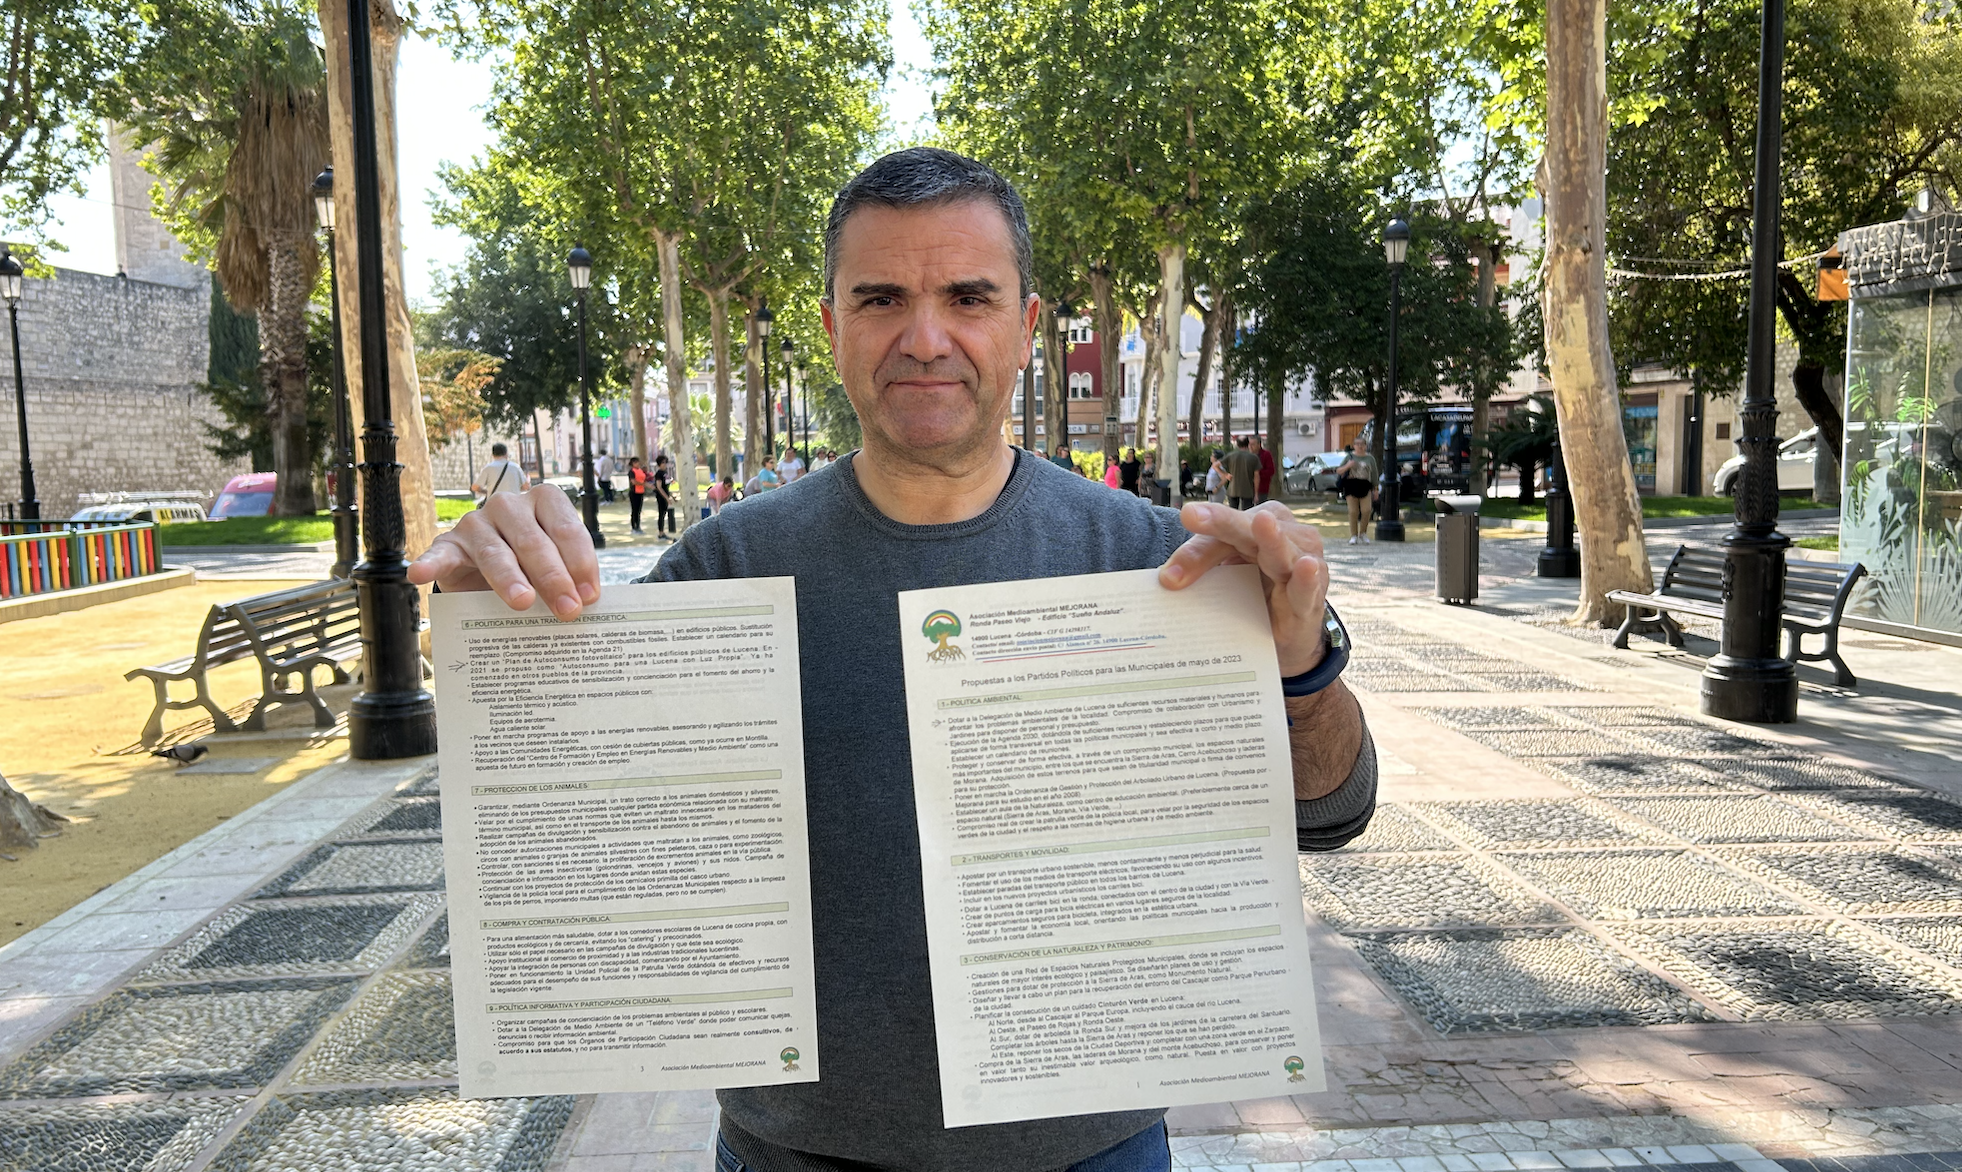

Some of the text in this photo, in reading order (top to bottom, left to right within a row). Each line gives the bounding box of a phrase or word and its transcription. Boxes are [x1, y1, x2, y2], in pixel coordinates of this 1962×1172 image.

[160, 508, 200, 520] ALARMAS
[968, 602, 1098, 619] Asociación Medioambiental MEJORANA
[969, 619, 991, 627] Ronda
[1014, 616, 1031, 624] Viejo
[1041, 612, 1067, 620] Edificio
[960, 676, 1005, 687] Propuestas
[1026, 671, 1059, 680] Partidos
[1060, 668, 1094, 677] Políticos
[1094, 668, 1113, 676] para
[1127, 661, 1175, 673] Municipales
[1188, 659, 1210, 668] mayo
[1222, 655, 1242, 663] 2023
[553, 782, 588, 790] ANIMALES:
[972, 851, 1024, 861] TRANSPORTES
[1030, 847, 1070, 856] MOVILIDAD:
[527, 916, 580, 925] CONTRATACIÓN
[581, 914, 612, 922] PÚBLICA:
[972, 949, 1030, 962] CONSERVACIÓN
[1052, 944, 1099, 954] NATURALEZA
[497, 1003, 528, 1011] POLÍTICA
[579, 998, 631, 1007] PARTICIPACIÓN
